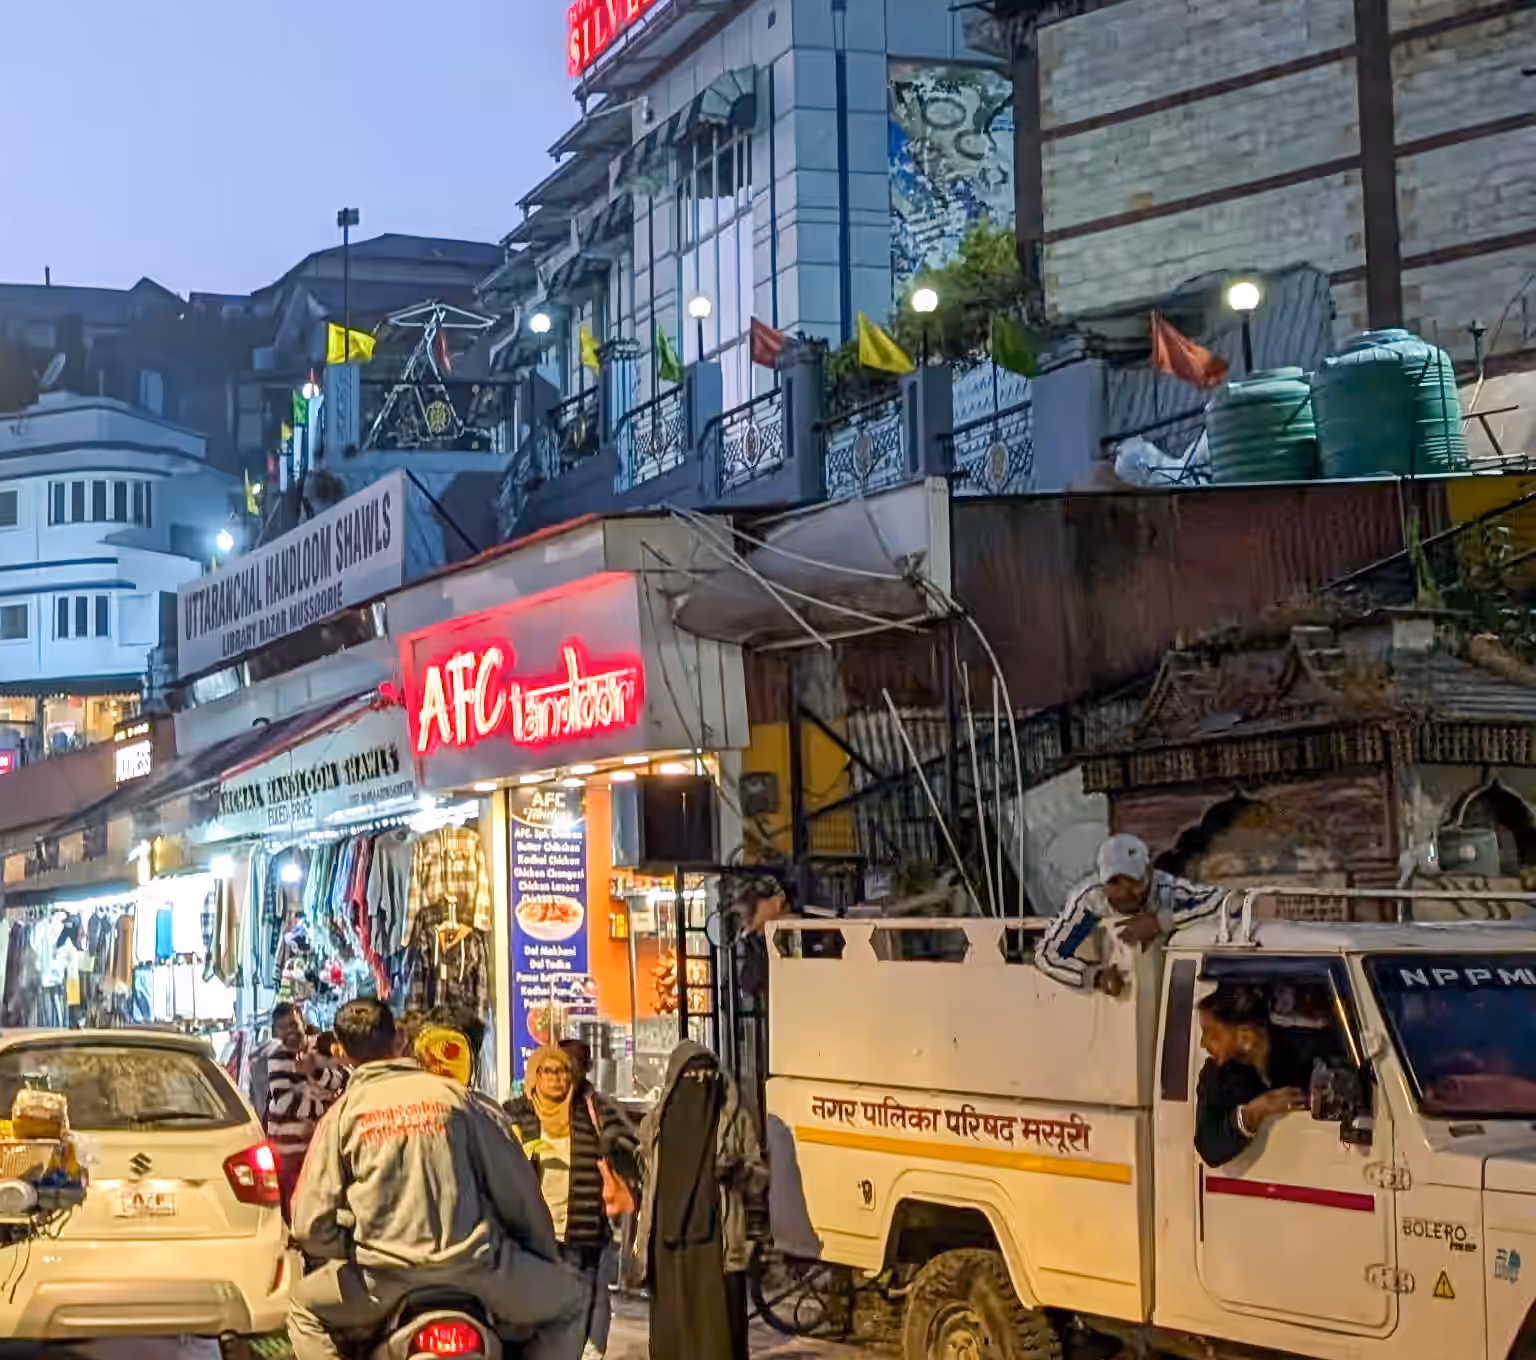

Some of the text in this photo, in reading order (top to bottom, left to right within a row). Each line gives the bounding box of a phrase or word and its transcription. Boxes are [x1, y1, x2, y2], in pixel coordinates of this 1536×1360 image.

[185, 490, 392, 641] UTTARANCHAL HANDLOOM SHAWLS
[221, 623, 258, 658] LIBRARY
[289, 579, 344, 631] MUSSOORIE
[417, 645, 507, 752] AFC
[267, 759, 340, 805] HANDLOOM
[343, 743, 400, 786] SHAWLS
[531, 791, 567, 808] AFC
[267, 798, 314, 826] FIXED PRICE
[811, 1095, 859, 1128] नगर
[860, 1095, 942, 1133] पालिका
[1020, 1111, 1093, 1153] मसूरी
[1402, 1218, 1467, 1242] BOLERO
